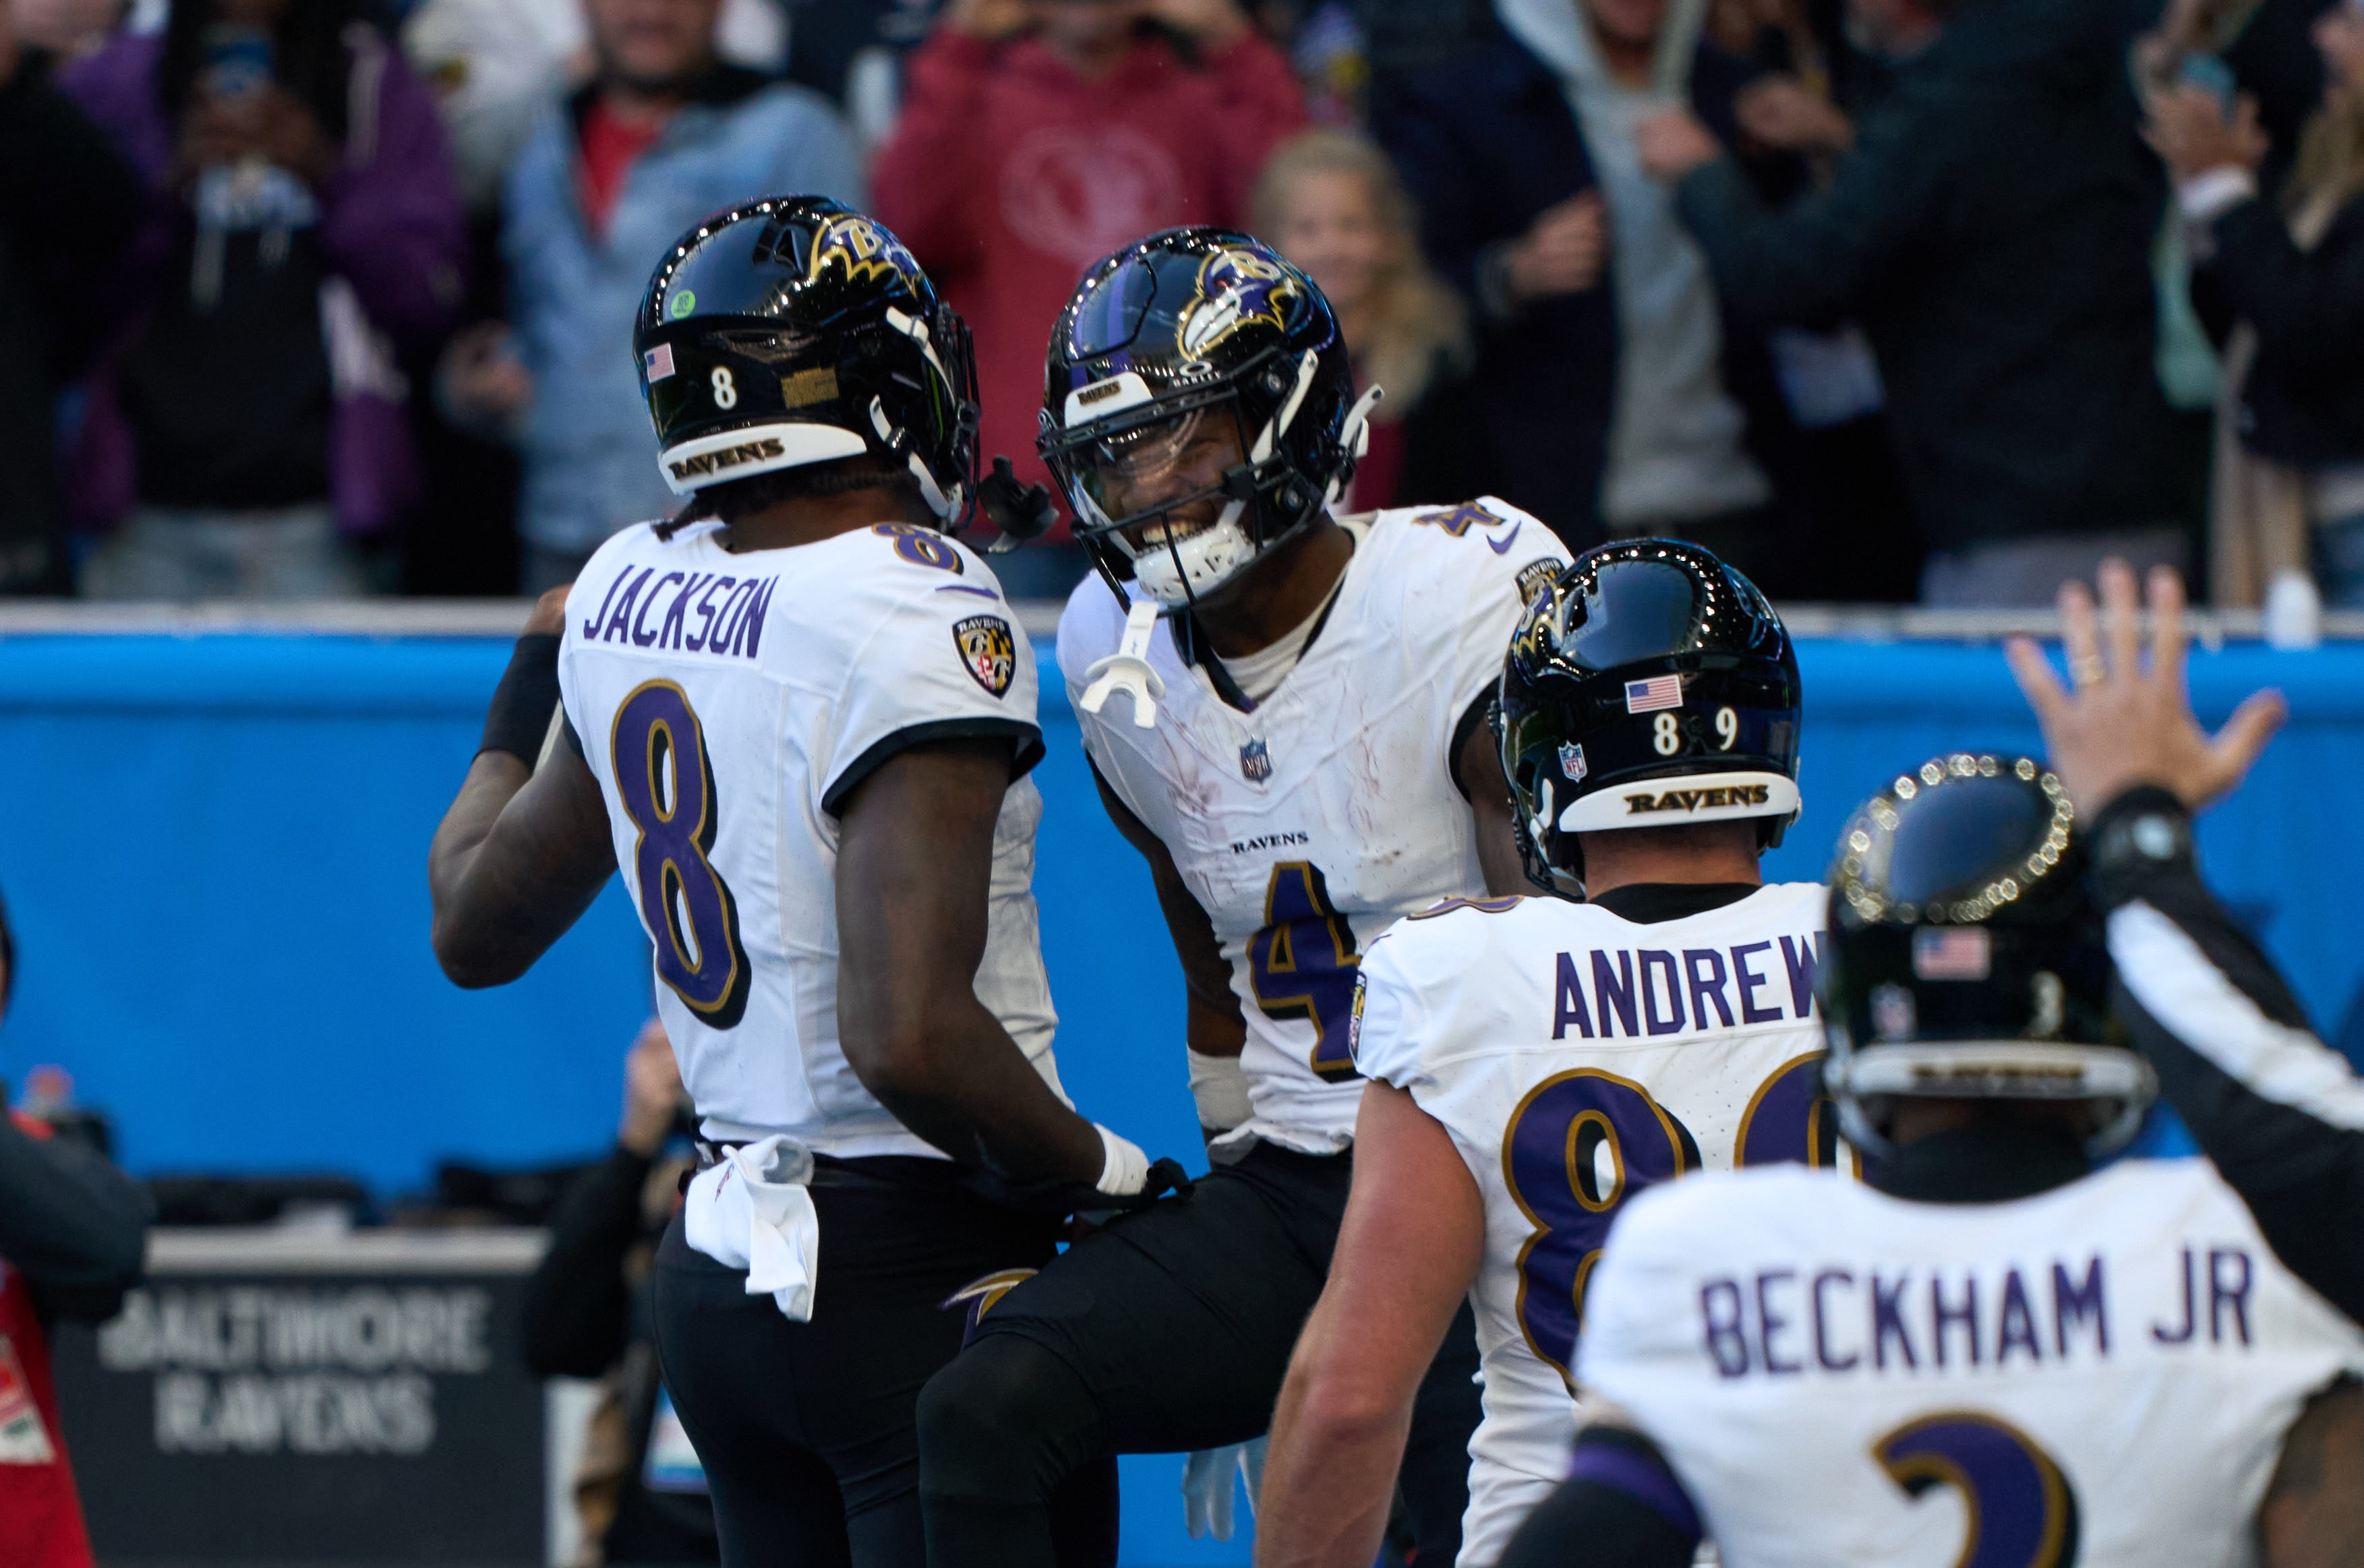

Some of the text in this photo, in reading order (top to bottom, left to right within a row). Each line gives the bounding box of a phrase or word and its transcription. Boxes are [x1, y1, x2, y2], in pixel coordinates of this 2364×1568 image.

[711, 366, 738, 410] 8
[1077, 381, 1121, 406] RAVENS
[668, 438, 785, 480] RAVENS
[1518, 559, 1562, 585] RAVENS
[583, 564, 780, 659] JACKSON
[957, 617, 1005, 633] RAVENS
[1565, 758, 1585, 775] NFL
[1623, 784, 1769, 814] RAVENS
[611, 678, 752, 1029] 8
[1231, 831, 1309, 853] RAVENS
[1245, 861, 1363, 1083] 4
[1701, 1243, 2253, 1379] BECKHAM JR
[154, 1376, 436, 1455] RAVENS
